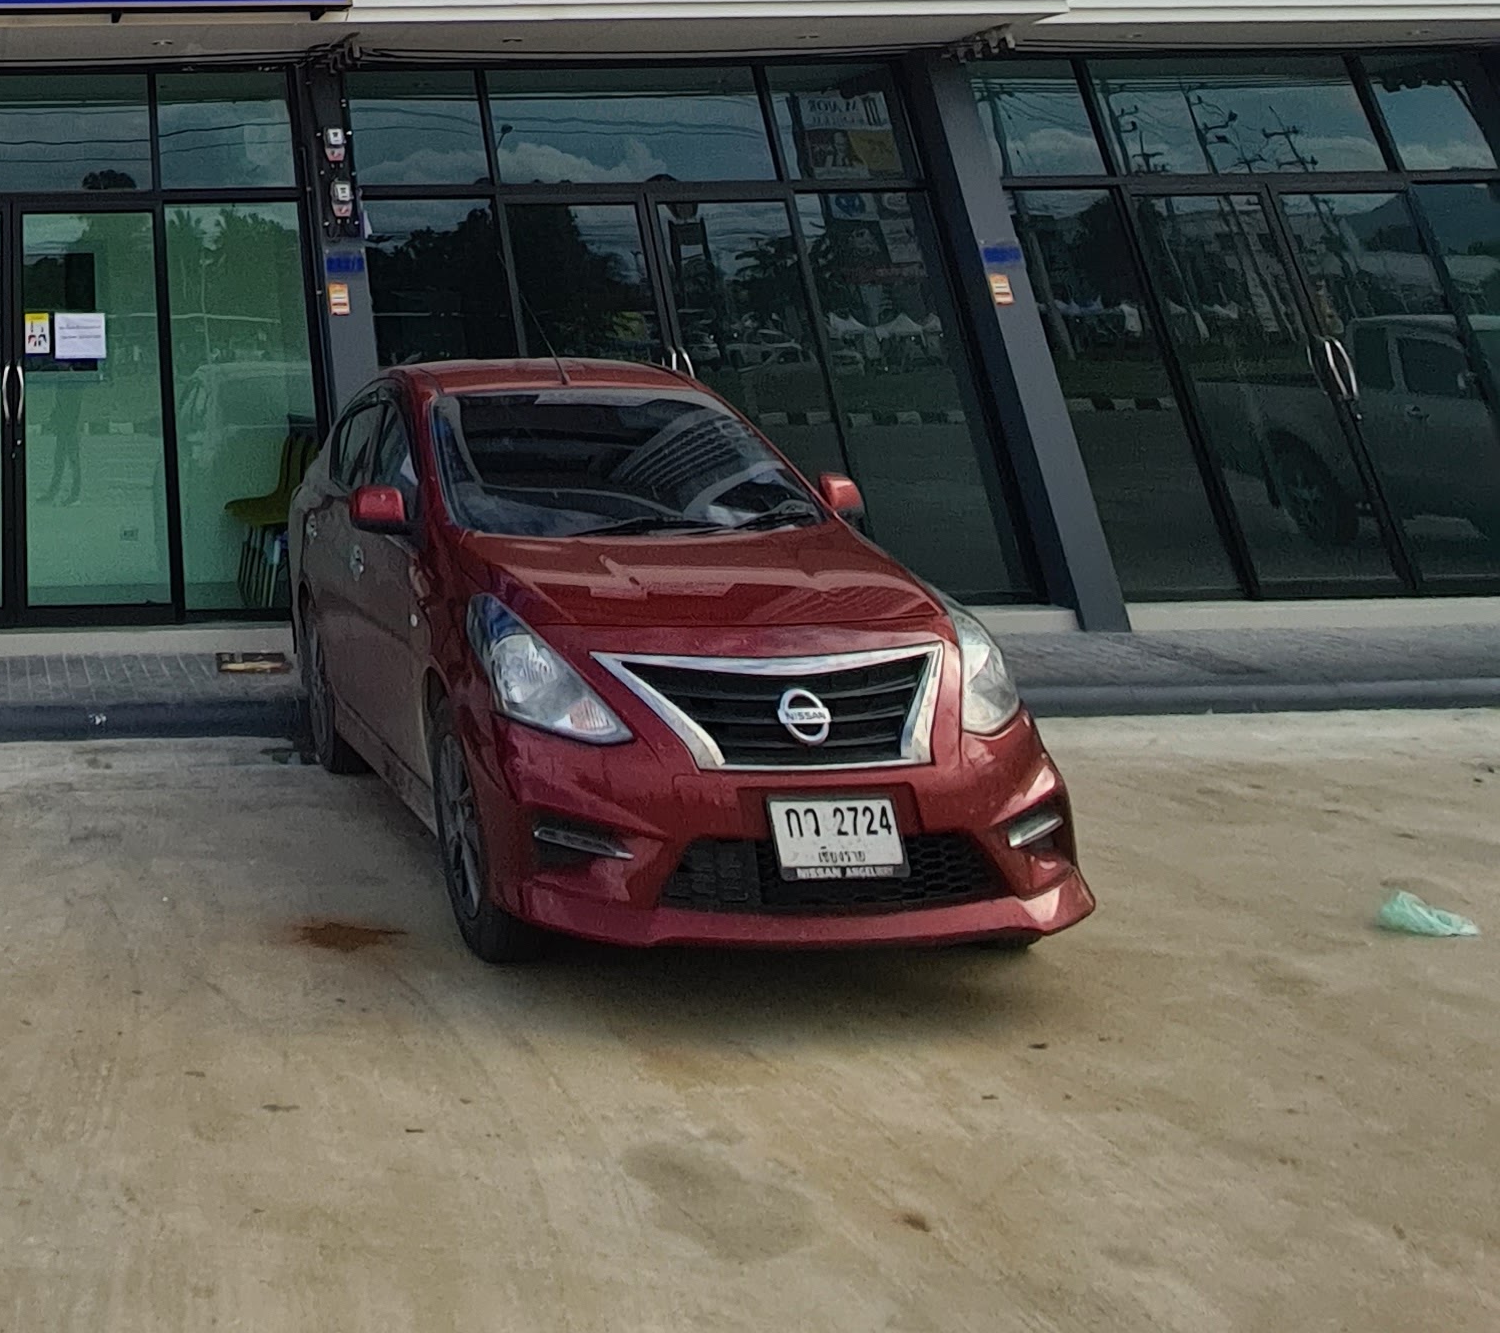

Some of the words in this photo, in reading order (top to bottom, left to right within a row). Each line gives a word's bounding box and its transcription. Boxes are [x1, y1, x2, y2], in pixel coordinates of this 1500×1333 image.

[786, 711, 826, 720] NISSAN
[785, 808, 821, 838] กว
[833, 805, 892, 836] 2724
[818, 846, 865, 864] เชียงราย
